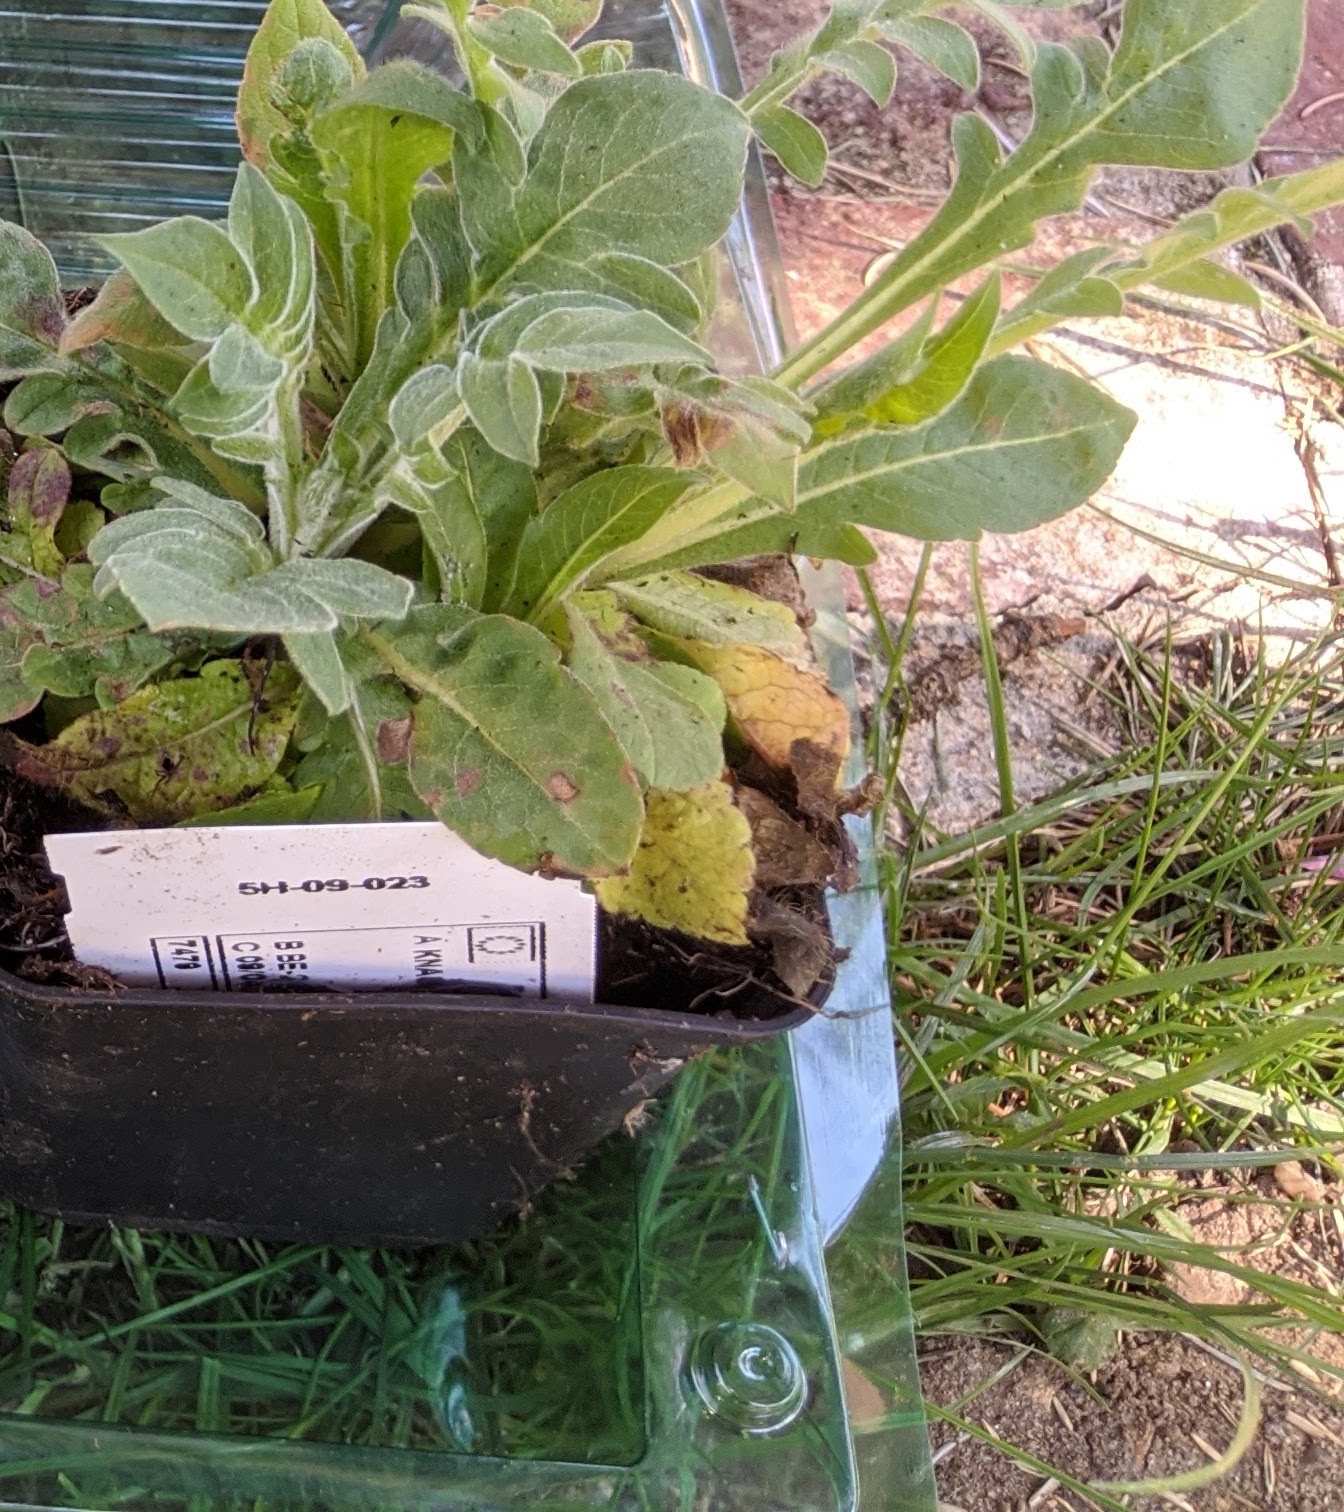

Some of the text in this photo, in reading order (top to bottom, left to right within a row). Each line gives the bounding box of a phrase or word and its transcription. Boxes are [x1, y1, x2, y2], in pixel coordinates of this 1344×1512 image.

[238, 876, 430, 895] 5H-09-023
[413, 935, 443, 945] A
[231, 942, 260, 952] C
[274, 941, 304, 950] B
